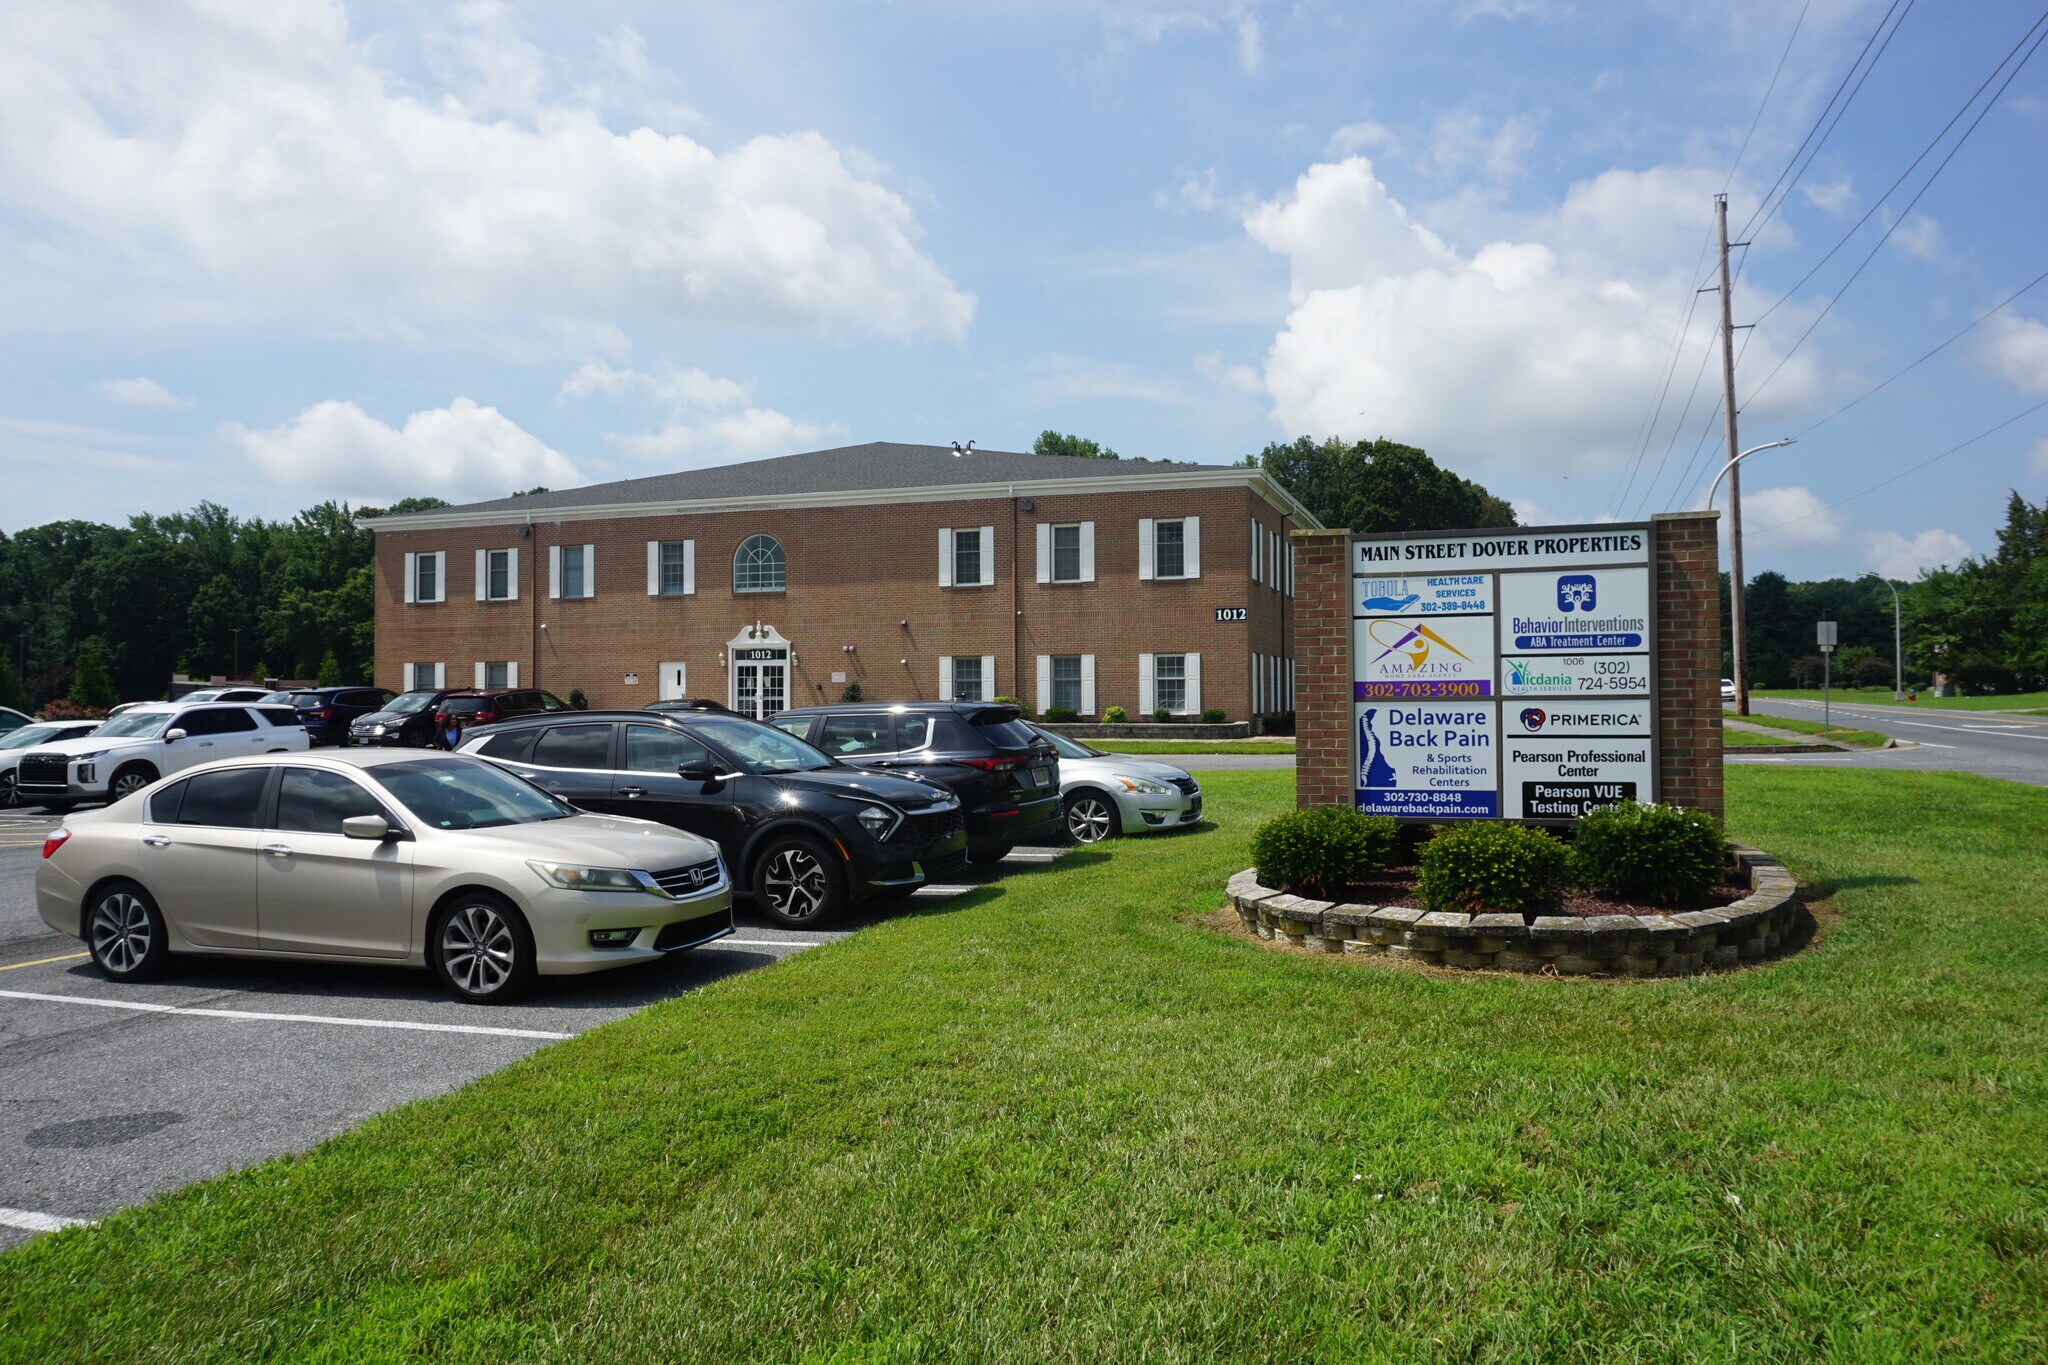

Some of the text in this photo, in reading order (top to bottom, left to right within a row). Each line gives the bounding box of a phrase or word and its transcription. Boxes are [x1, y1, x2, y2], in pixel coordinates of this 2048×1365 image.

[1361, 535, 1641, 561] MAIN STREET DOVER PROPERTIES
[1427, 576, 1484, 587] HEALTH CARE
[1362, 580, 1409, 598] TOBOLA
[1436, 589, 1476, 598] SERVICES
[1421, 600, 1485, 612] 302-389-8448
[1216, 608, 1247, 620] 1012
[1530, 635, 1626, 647] ABA Treatment Center
[750, 650, 772, 659] 1012
[1379, 662, 1462, 674] AMAZING
[1562, 658, 1584, 666] 1006
[1593, 661, 1630, 675] (302)
[1577, 676, 1646, 690] 724-5954
[1364, 682, 1480, 697] 302-703-3900
[1389, 708, 1487, 726] Delaware
[1550, 714, 1640, 726] PRIMERICA
[1389, 729, 1489, 747] Back Pain
[1437, 753, 1472, 765] Sports
[1512, 750, 1646, 763] Pearson Professional
[1412, 765, 1487, 775] Rehabilitation
[1558, 764, 1599, 777] Center
[1429, 777, 1470, 787] Centers
[1383, 792, 1462, 802] 302-730-8848
[1535, 784, 1623, 798] Pearson VUE
[1357, 802, 1489, 815] delawarebackpain.com
[1530, 800, 1623, 816] Testing Cete
